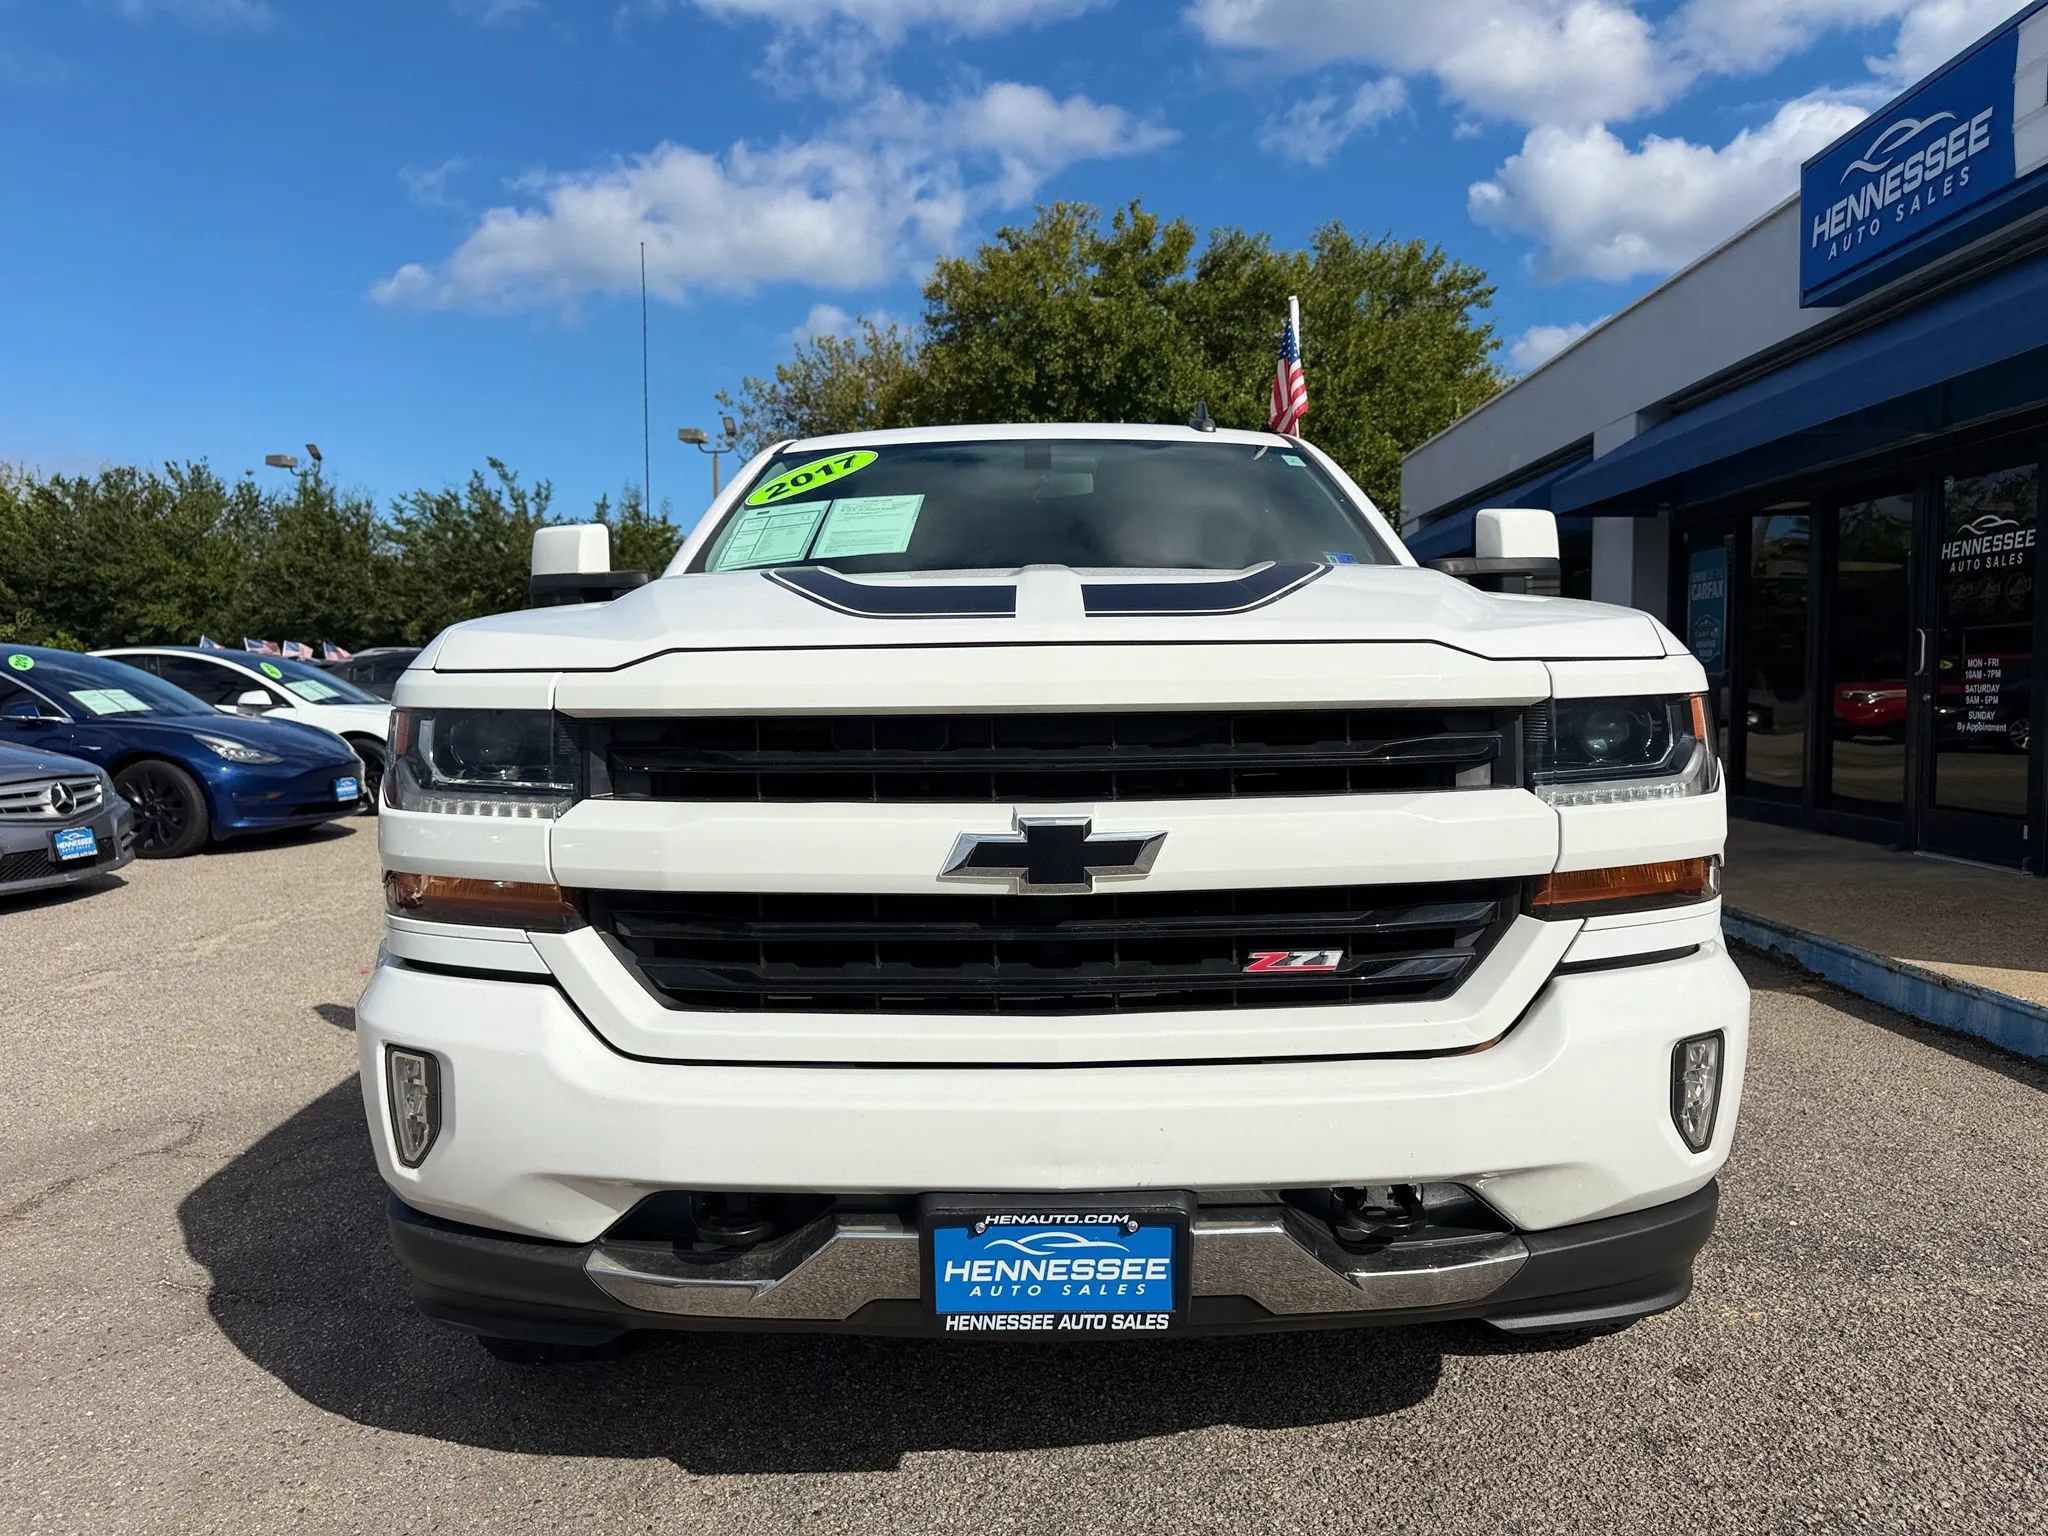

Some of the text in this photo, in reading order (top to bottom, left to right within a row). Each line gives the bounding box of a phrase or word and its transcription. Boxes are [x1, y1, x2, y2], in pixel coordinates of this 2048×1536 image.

[1812, 106, 1993, 248] HENNESSEE
[1828, 165, 1971, 261] AUTO SALES
[765, 454, 857, 500] 2017
[1941, 528, 2037, 560] HENNESSEE
[1950, 551, 2023, 574] AUTO SALES
[1692, 580, 1724, 601] CARFAX
[1967, 658, 1983, 668] MON
[1987, 657, 2000, 667] FRI
[1987, 669, 2001, 679] 7PM
[1965, 684, 2000, 693] SATURDAY
[1968, 711, 1996, 720] SUNDAY
[1957, 721, 2007, 733] By Appointment
[1242, 950, 1344, 973] Z71
[985, 1214, 1129, 1225] HENAUTO.COM
[944, 1258, 1170, 1282] HENNESSEE
[969, 1283, 1146, 1297] AUTO SALES
[945, 1313, 1169, 1331] HENNESSEE AUTO SALES
